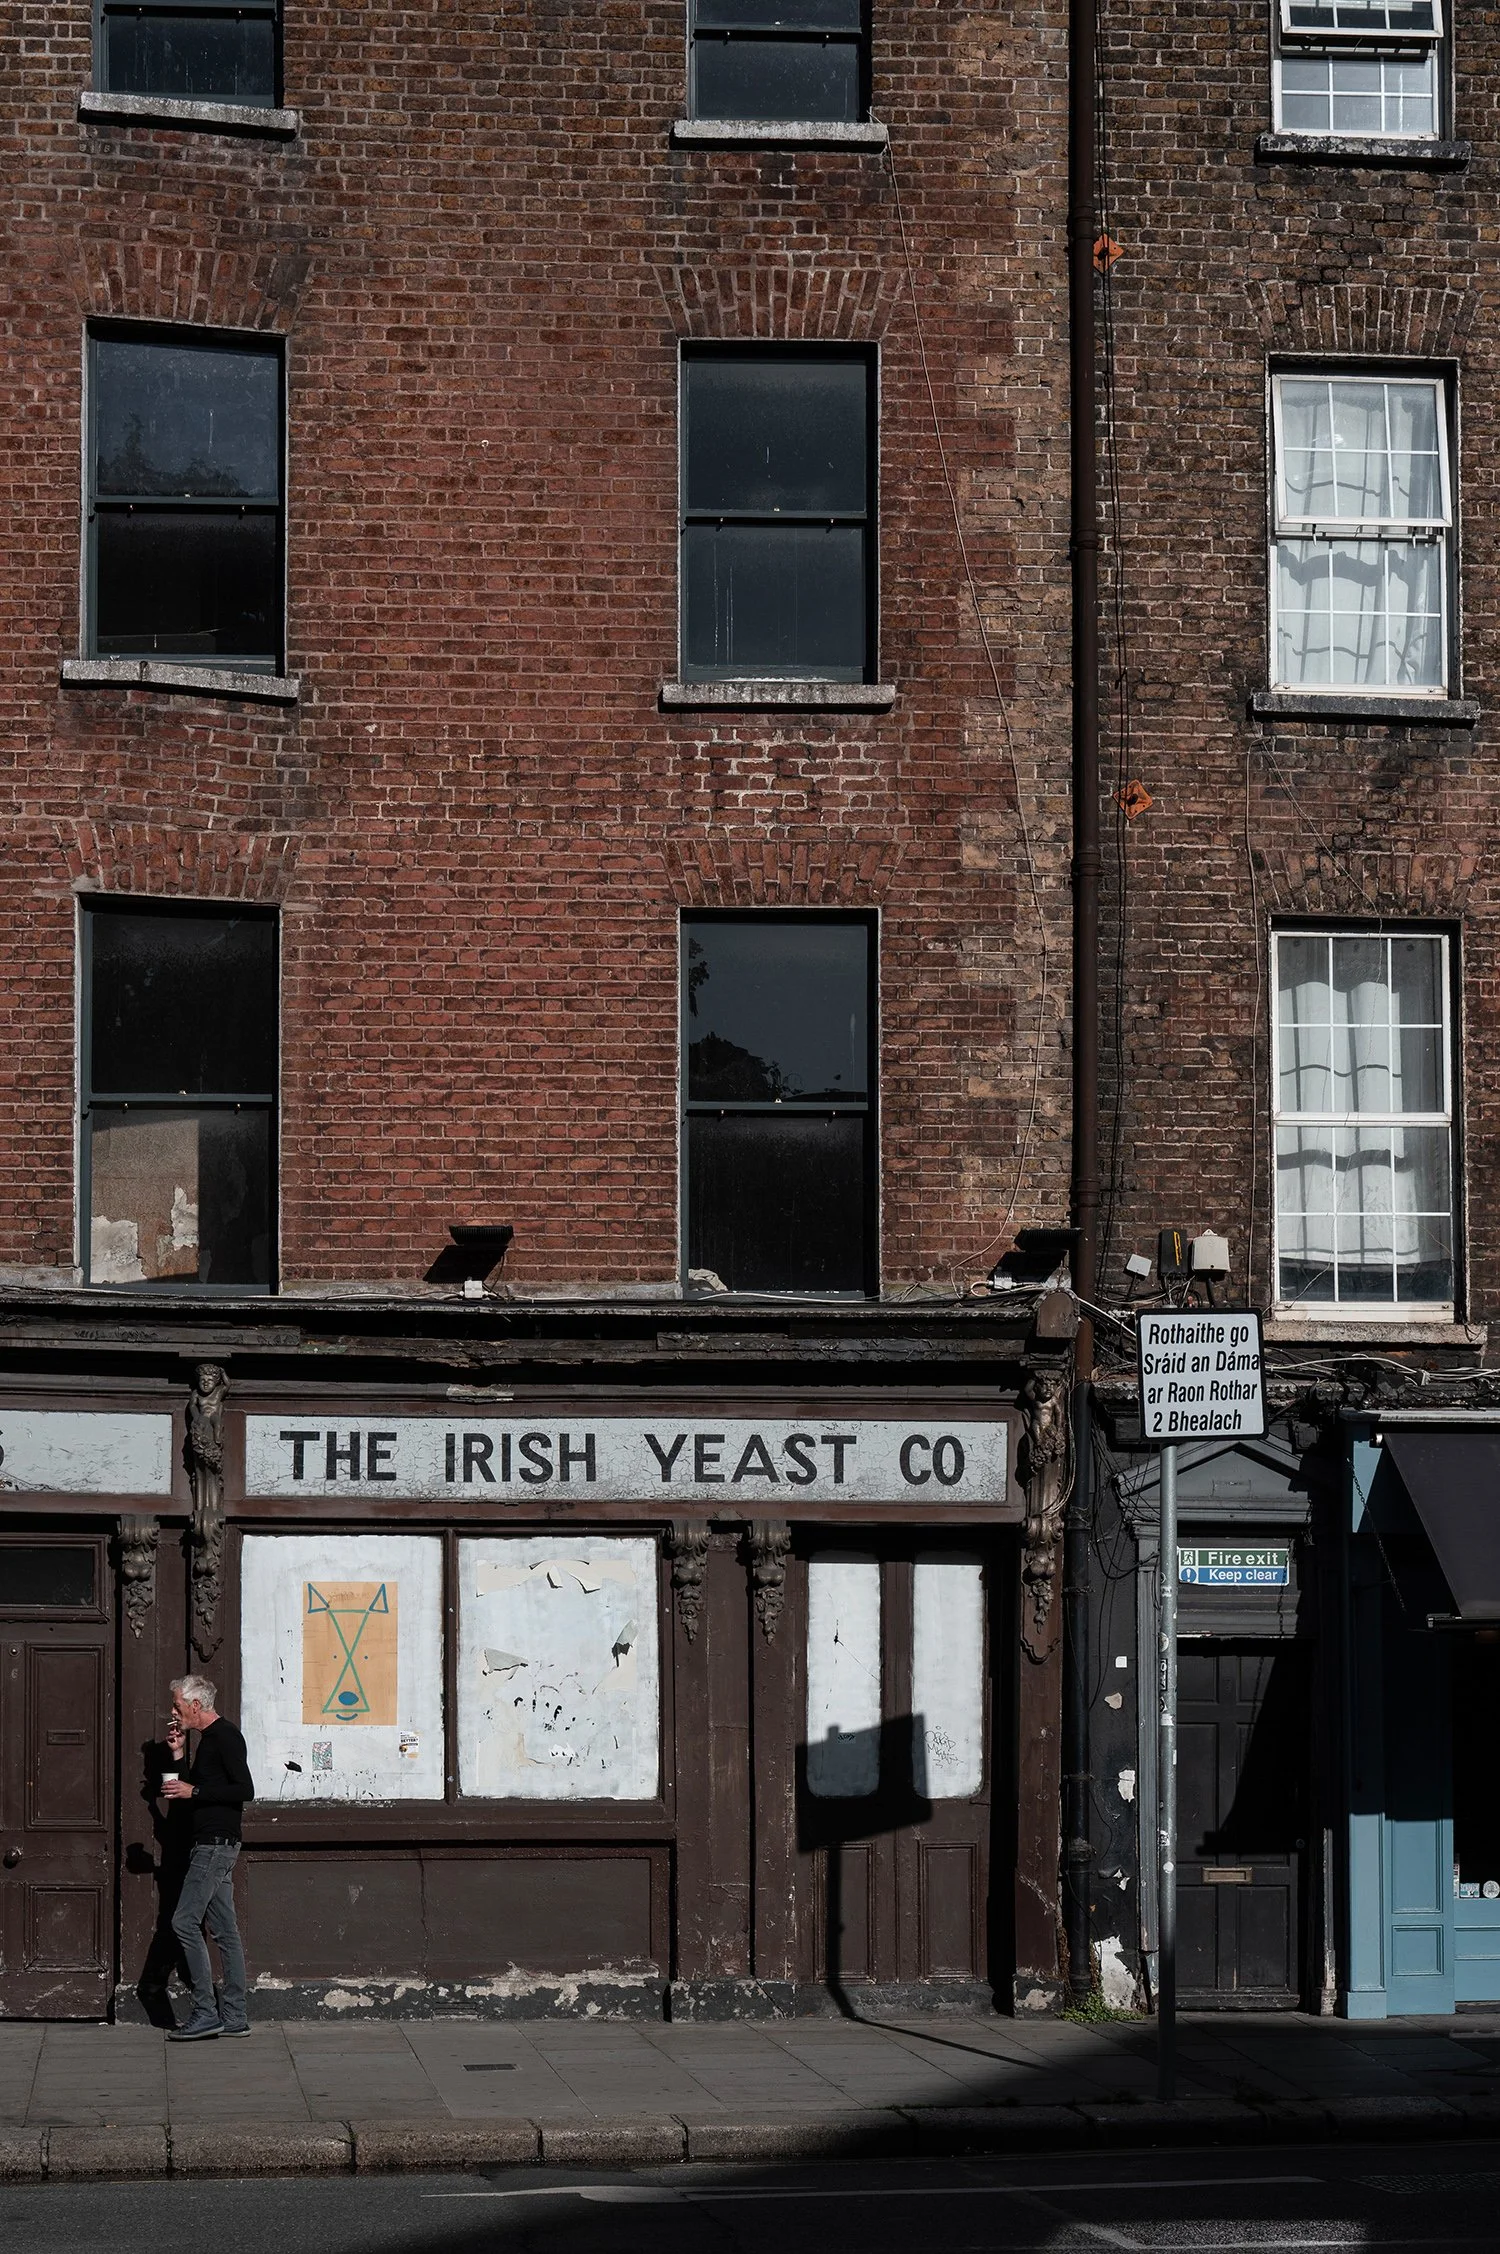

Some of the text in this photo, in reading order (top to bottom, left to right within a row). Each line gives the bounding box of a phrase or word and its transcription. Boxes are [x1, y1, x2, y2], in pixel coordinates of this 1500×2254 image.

[1149, 1323, 1249, 1347] Rothaithe go
[1143, 1351, 1260, 1375] Sráid an Dáma
[1147, 1379, 1258, 1404] ar Raon Rothar
[1152, 1409, 1242, 1433] 2 Bhealach
[280, 1430, 966, 1486] THE IRISH YEAST CO
[1208, 1551, 1279, 1565] Fire exit
[1209, 1568, 1278, 1583] Keep clear
